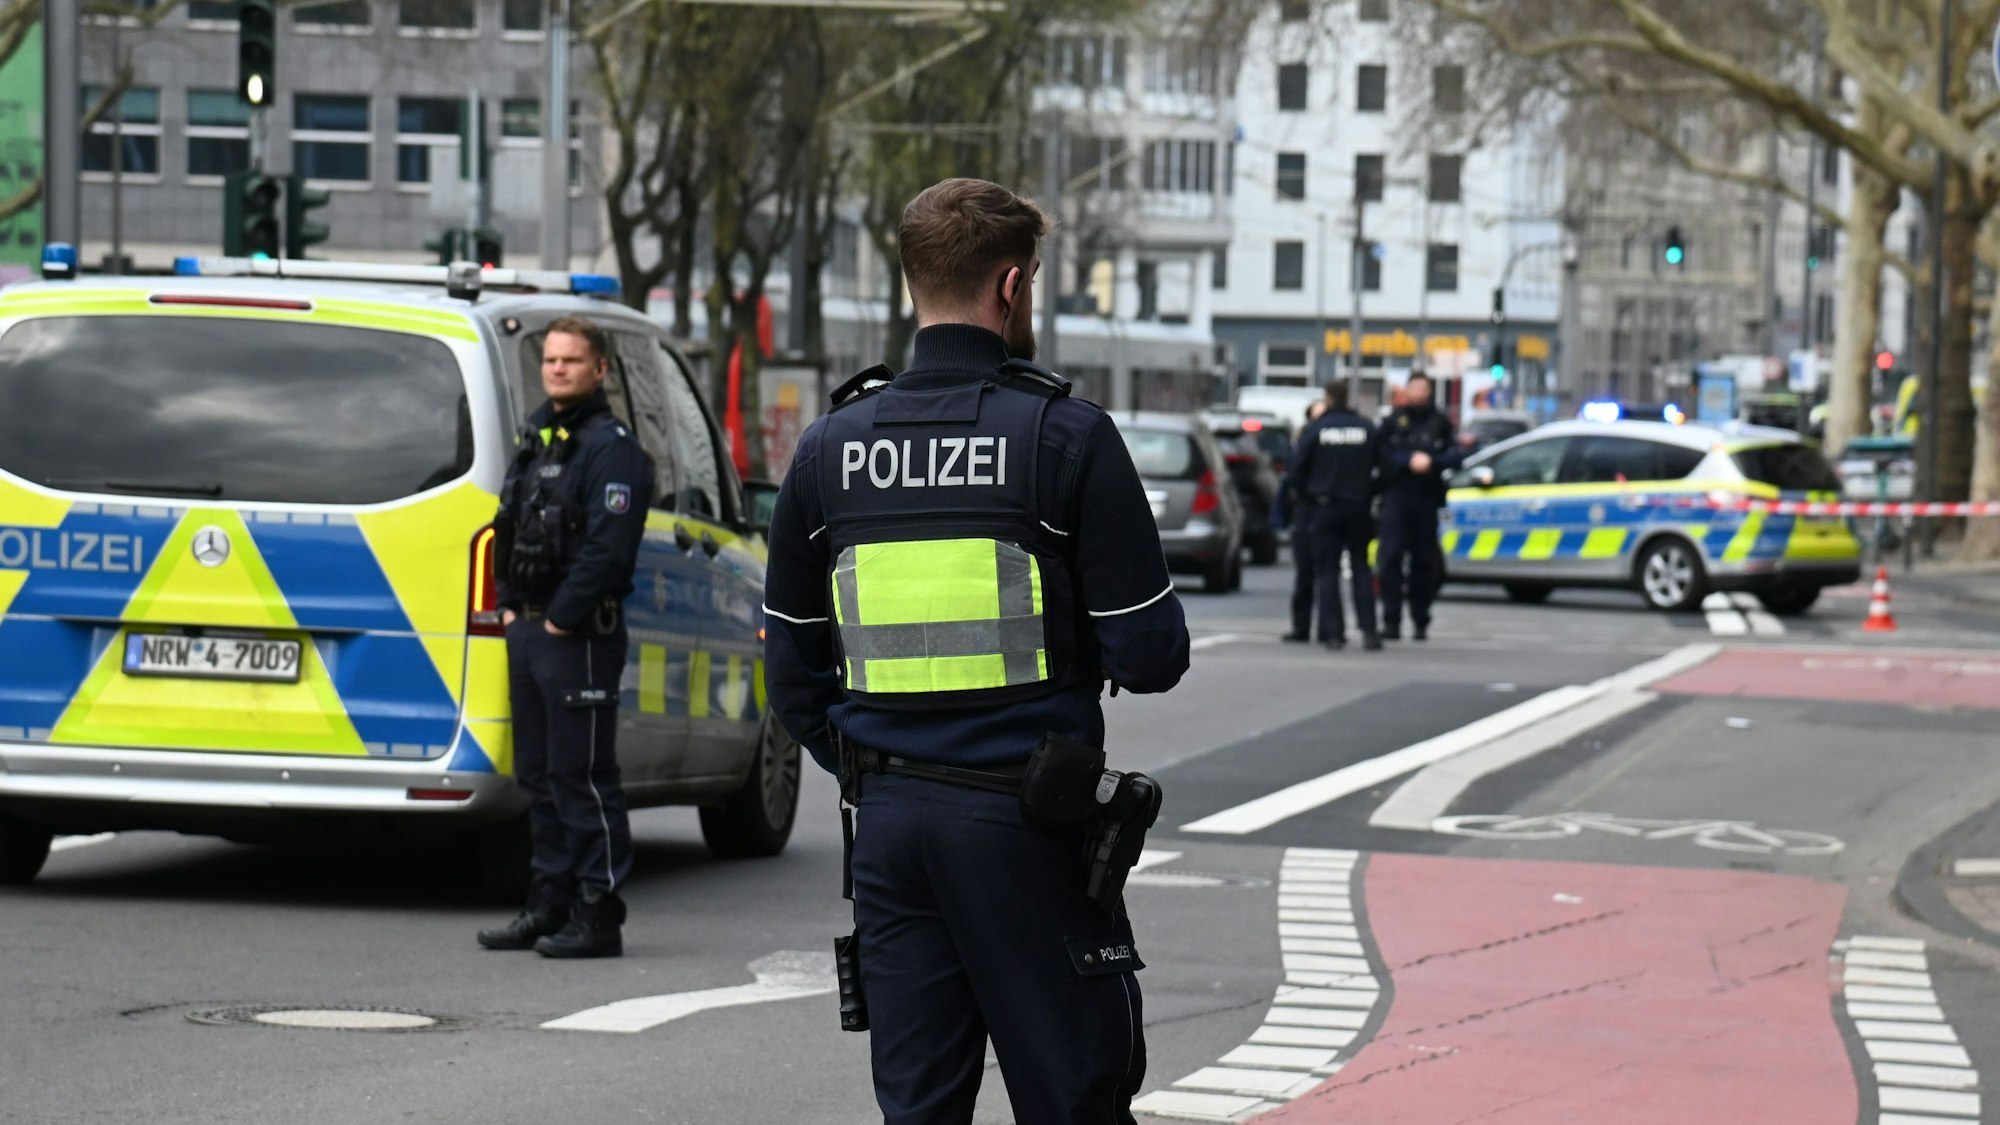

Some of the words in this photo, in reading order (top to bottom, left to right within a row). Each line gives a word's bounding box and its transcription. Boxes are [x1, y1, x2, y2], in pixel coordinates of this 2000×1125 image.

[1319, 426, 1367, 446] POLIZEI
[842, 436, 1007, 490] POLIZEI
[141, 638, 192, 667] NRW
[205, 641, 298, 671] 4-7009
[1099, 944, 1132, 962] POLIZEI
